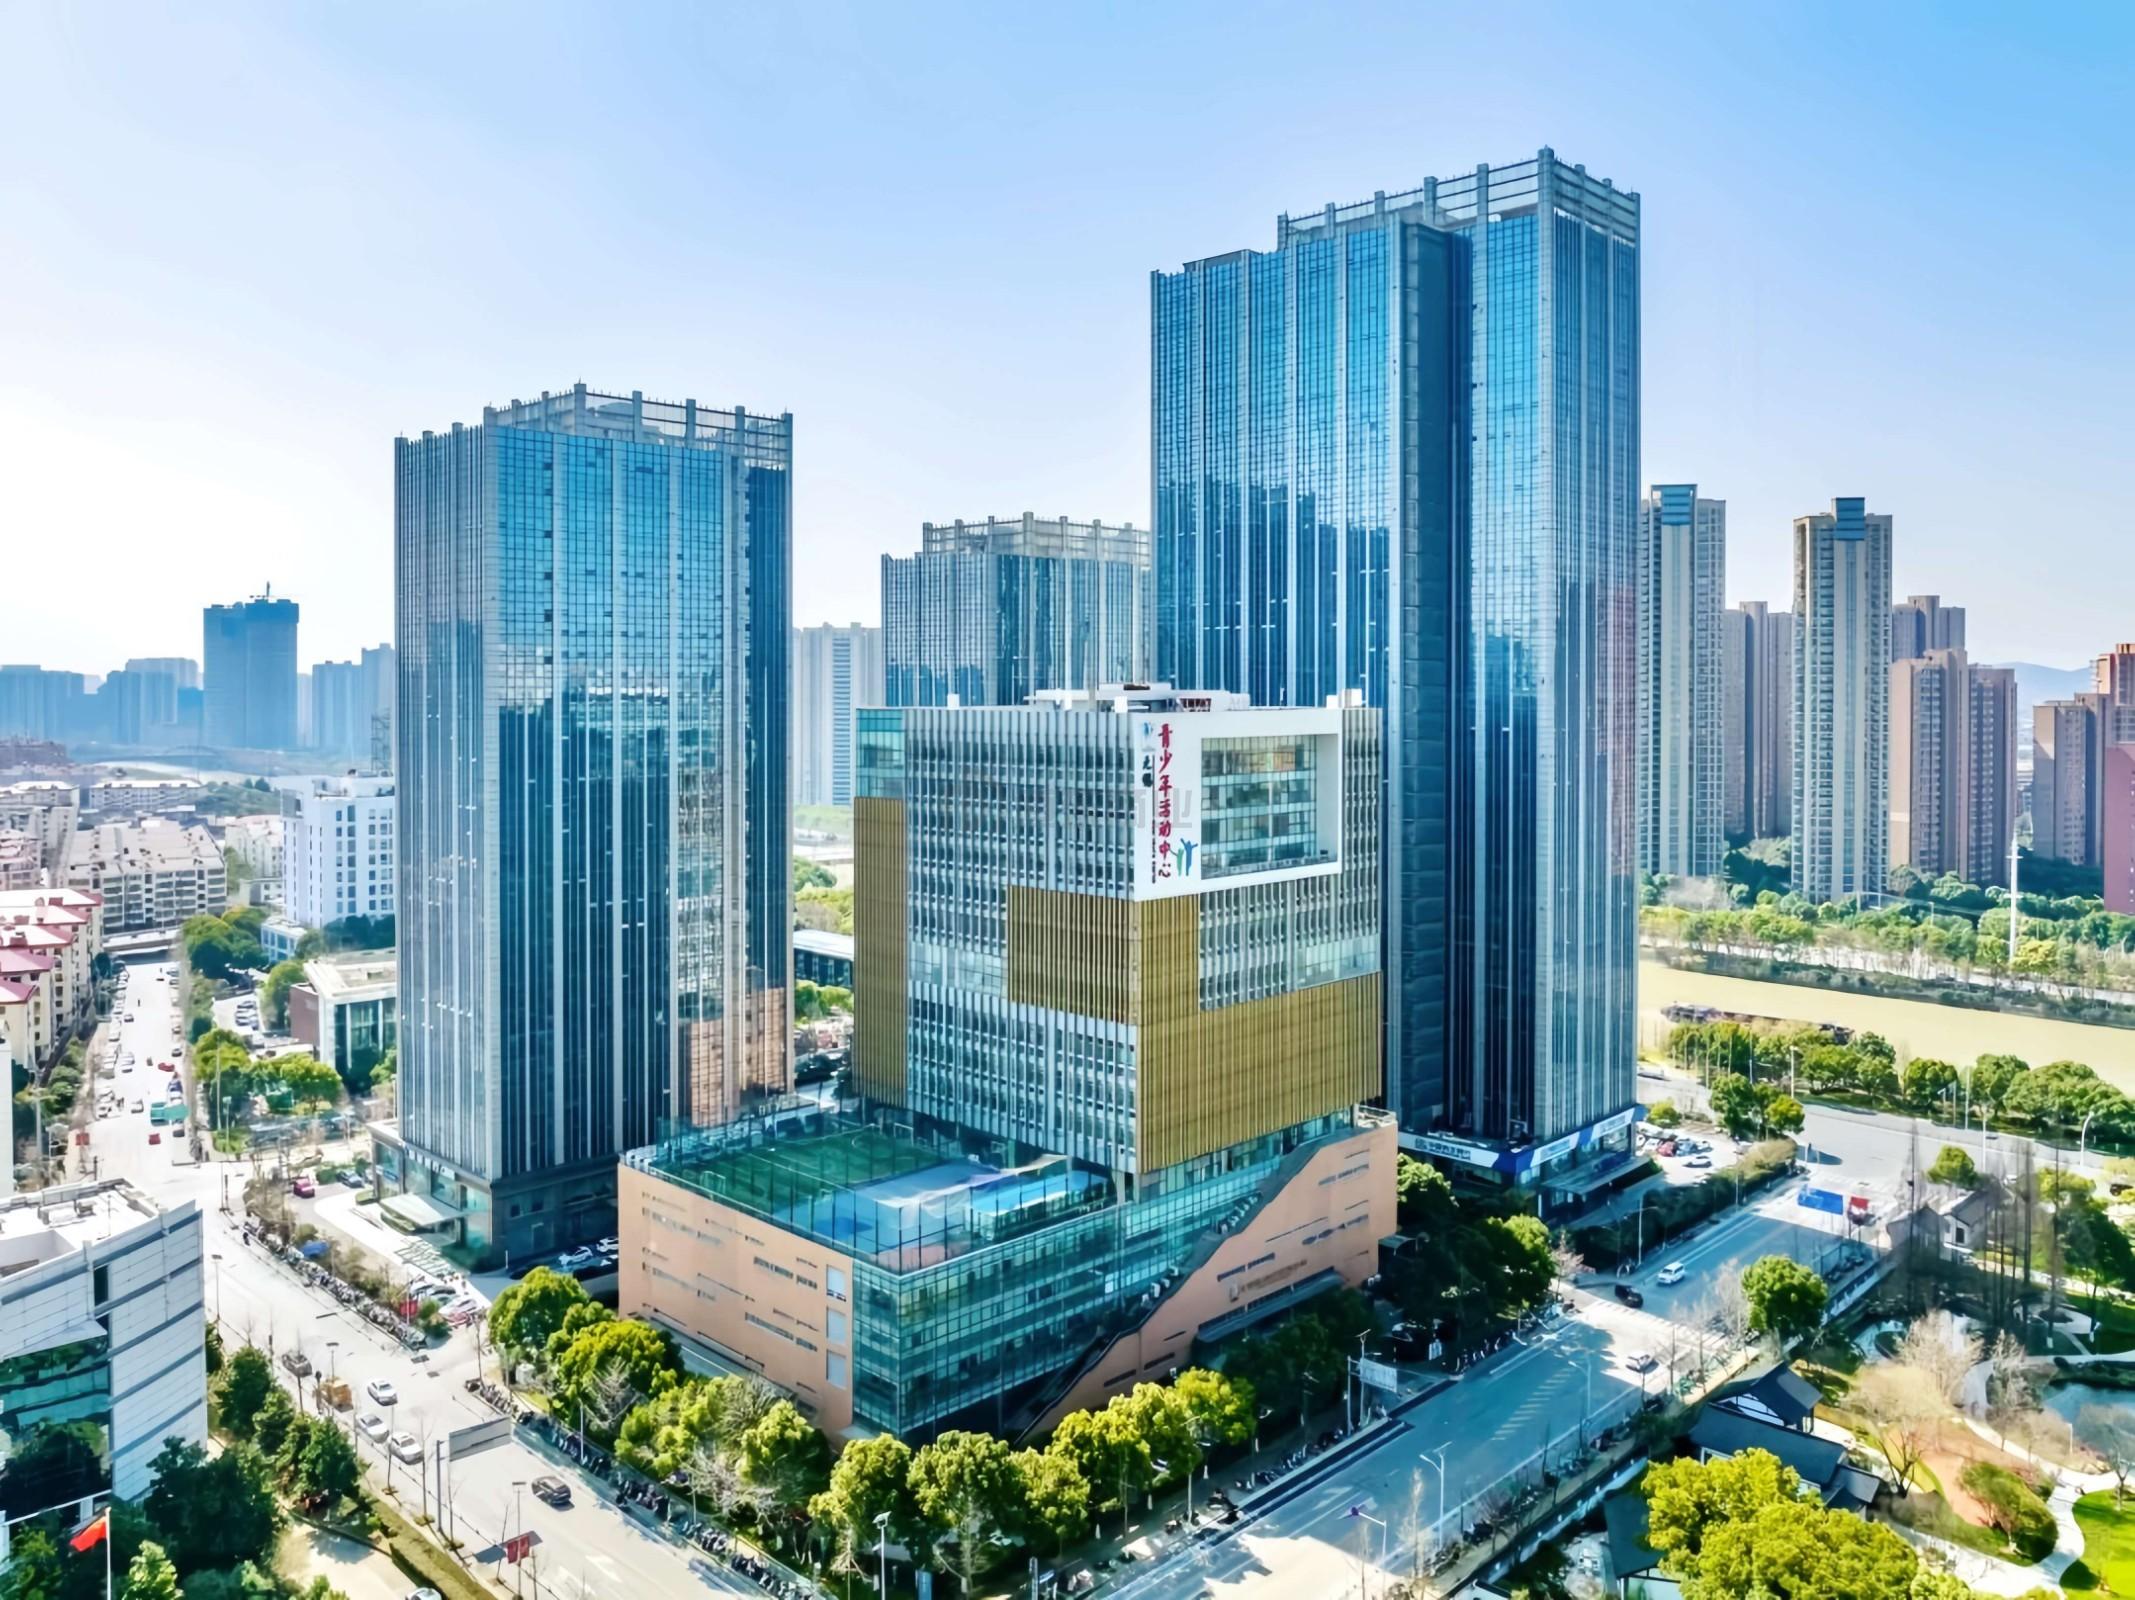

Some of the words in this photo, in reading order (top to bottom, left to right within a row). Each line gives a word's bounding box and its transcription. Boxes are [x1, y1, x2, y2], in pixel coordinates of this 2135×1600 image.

[1158, 723, 1173, 878] 青少年活动中心
